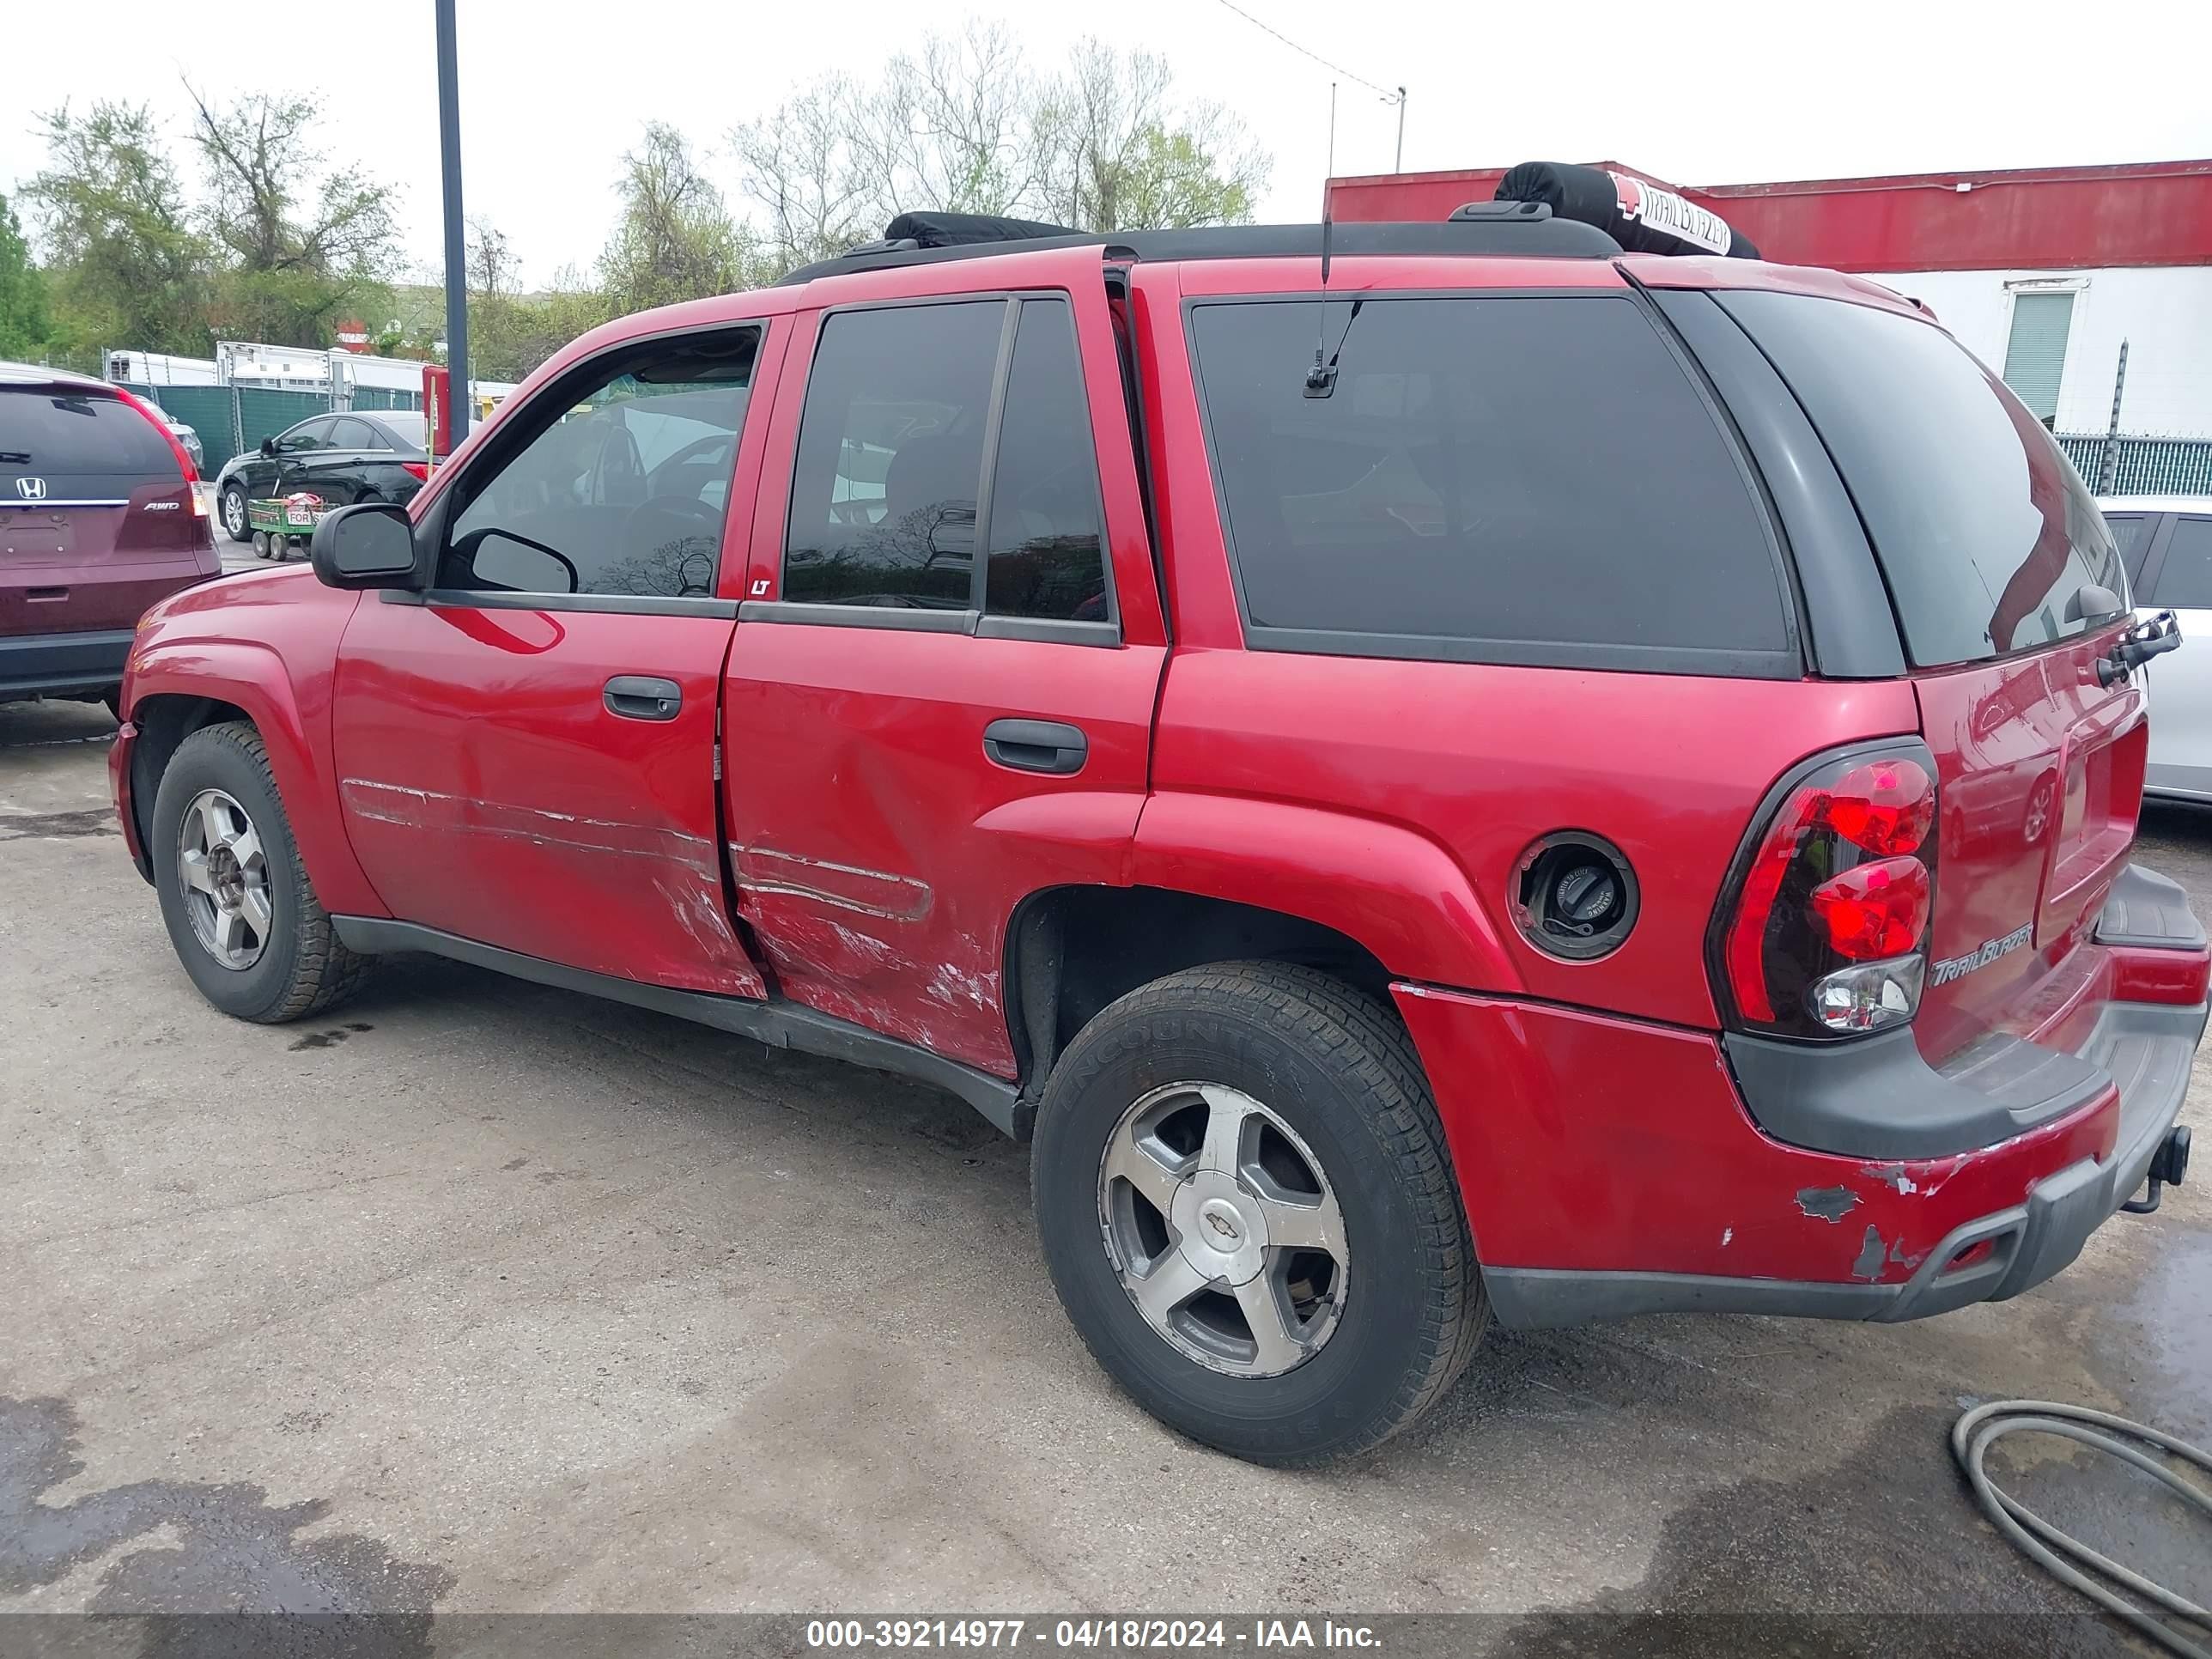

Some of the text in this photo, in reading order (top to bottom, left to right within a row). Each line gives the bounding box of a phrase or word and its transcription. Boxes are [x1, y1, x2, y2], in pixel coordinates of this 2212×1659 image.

[1635, 179, 1728, 249] TRAILBLAZER
[290, 514, 309, 523] FOR
[750, 580, 771, 595] LT
[1931, 921, 2034, 988] TRAILBLAZER
[1062, 1019, 1313, 1110] ENCOUNTER
